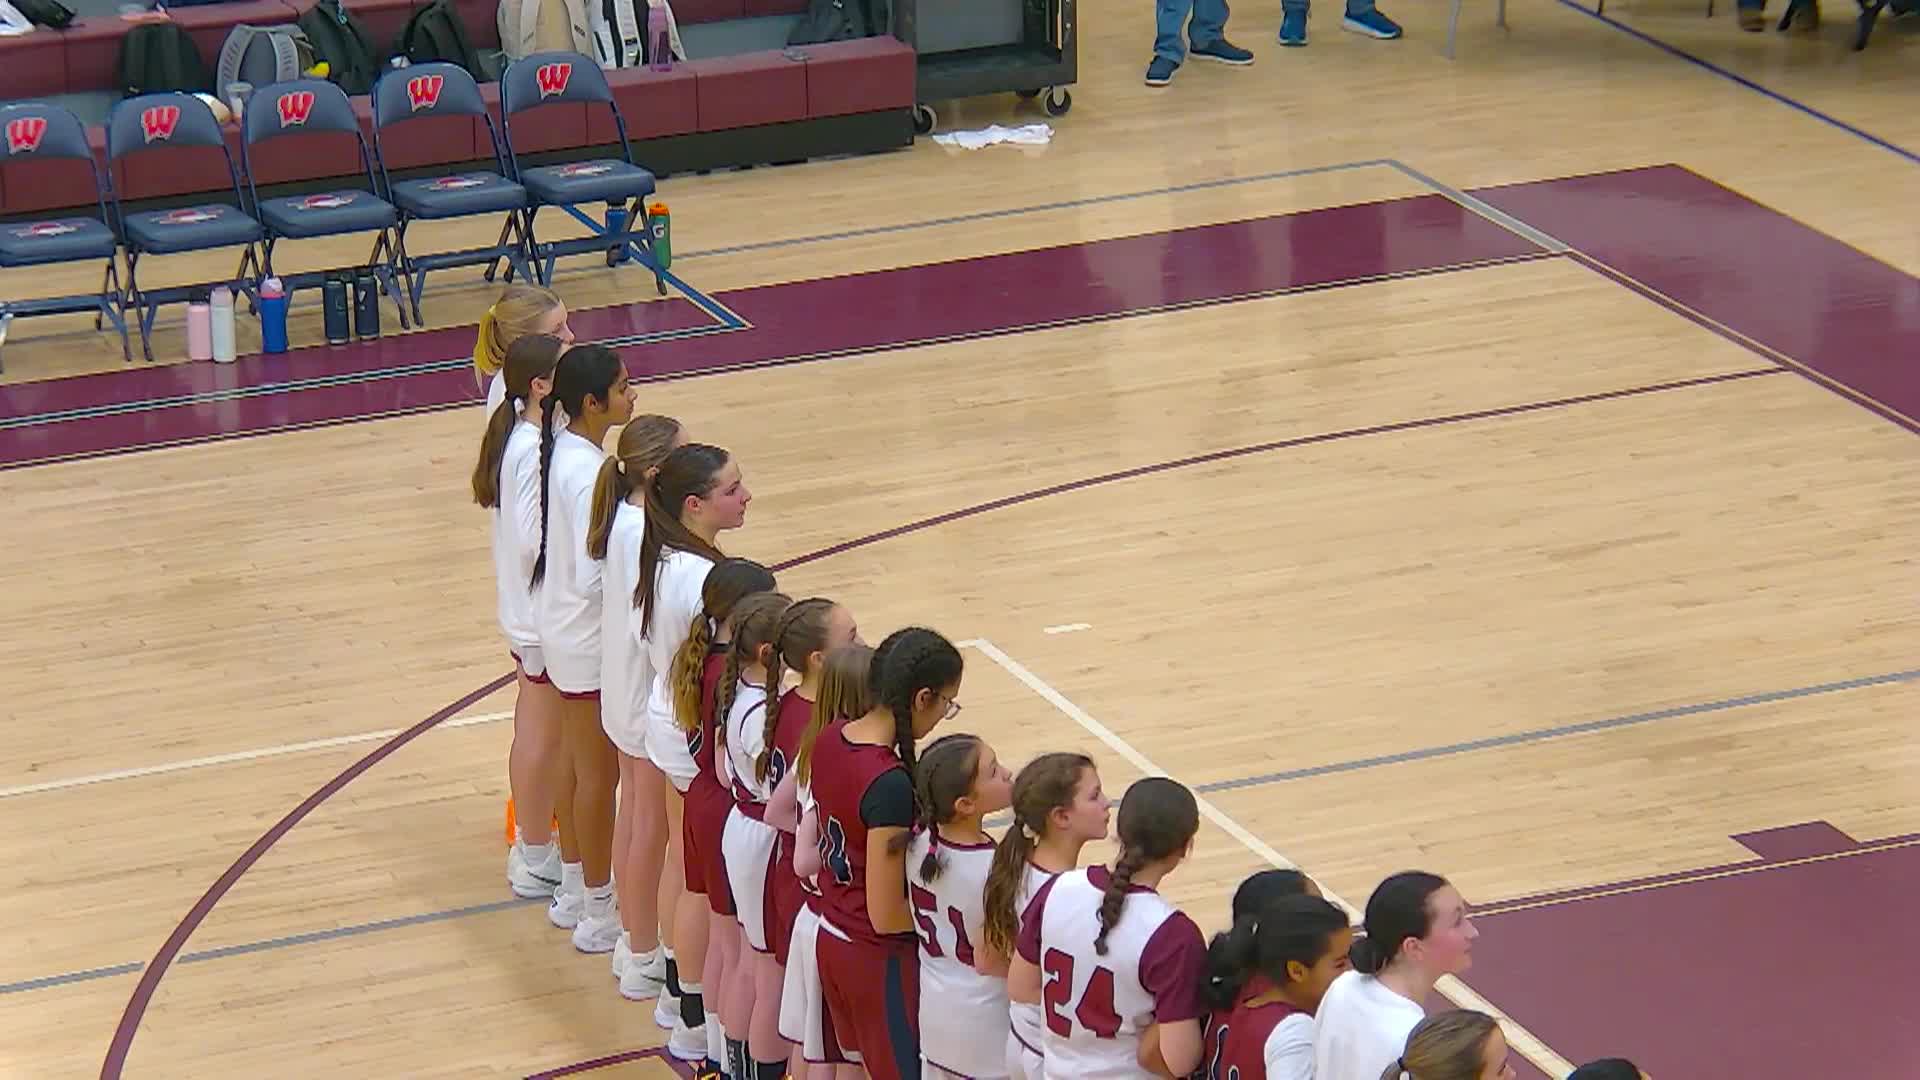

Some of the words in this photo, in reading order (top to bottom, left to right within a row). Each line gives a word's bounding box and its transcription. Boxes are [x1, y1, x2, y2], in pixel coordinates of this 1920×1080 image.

[407, 75, 443, 112] W
[535, 63, 572, 99] W
[140, 105, 181, 144] W
[275, 91, 316, 128] W
[5, 117, 48, 154] W
[652, 224, 666, 239] G
[911, 881, 975, 967] 51
[1043, 946, 1123, 1040] 24
